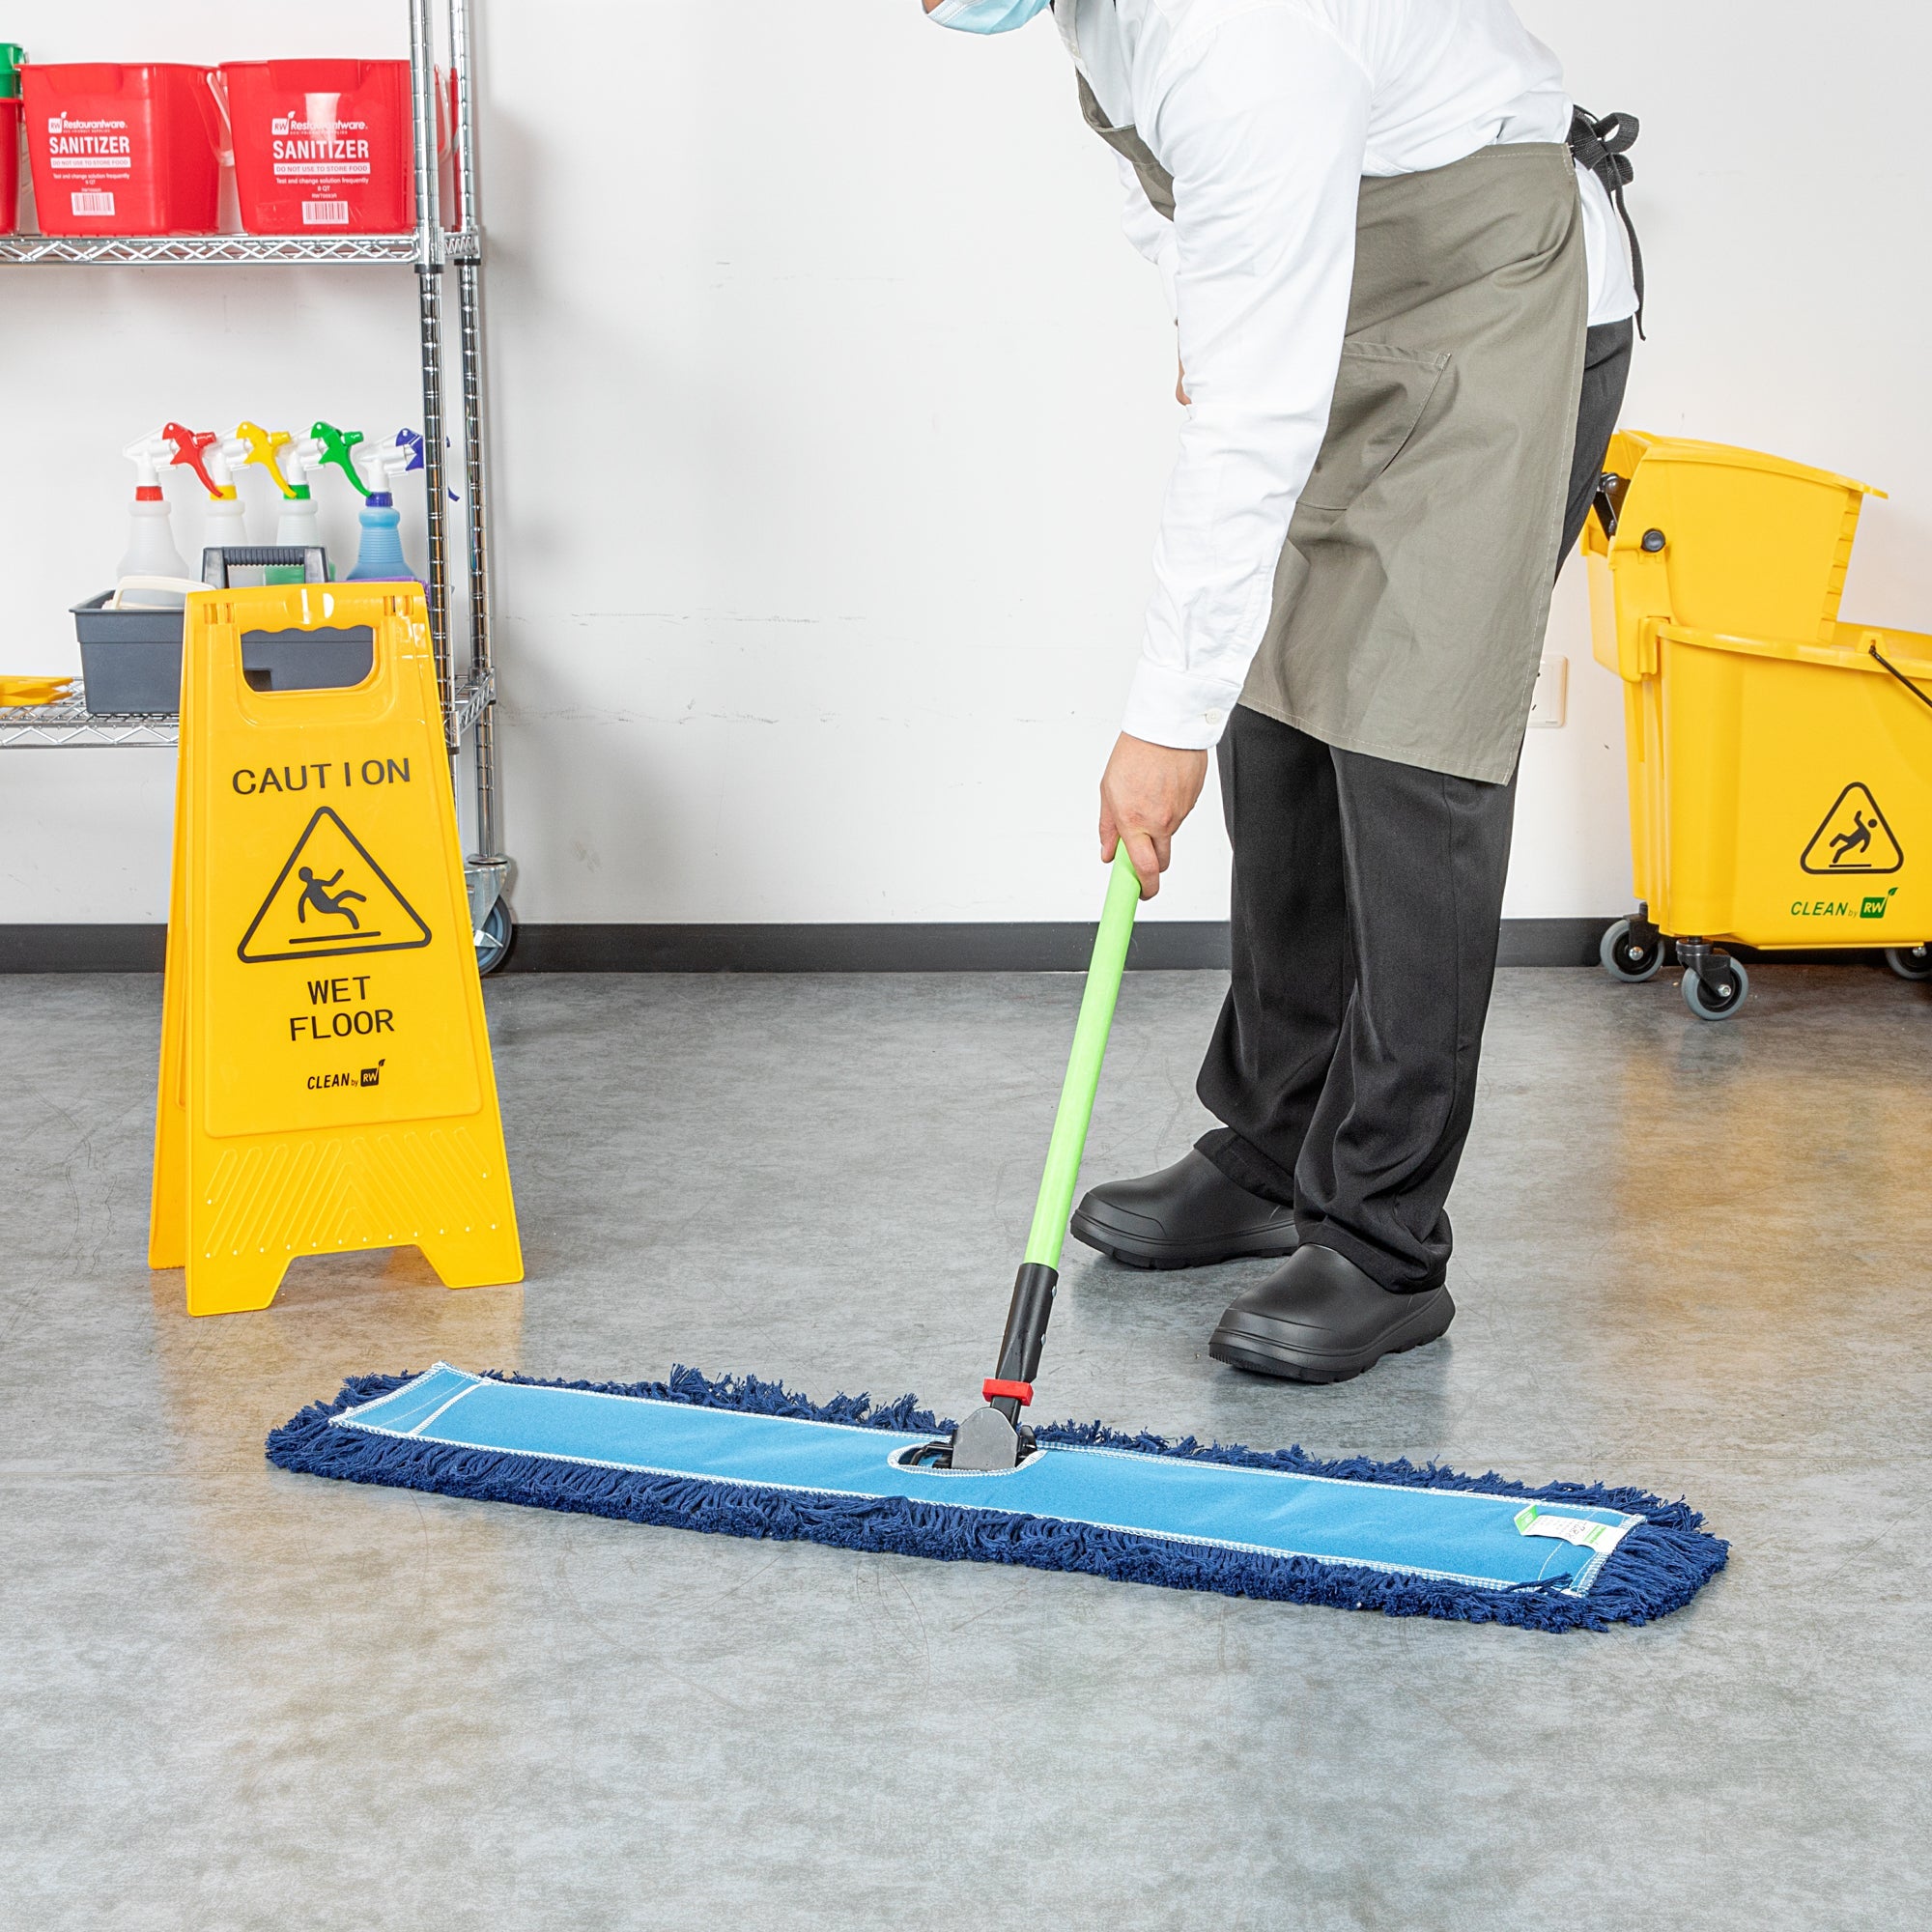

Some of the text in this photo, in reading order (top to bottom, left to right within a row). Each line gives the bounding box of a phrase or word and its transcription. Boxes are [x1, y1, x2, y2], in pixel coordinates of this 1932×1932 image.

[49, 136, 130, 155] SANITIZER
[272, 140, 369, 159] SANITIZER
[232, 757, 411, 795] CAUTION
[1790, 901, 1848, 916] CLEAN
[1848, 909, 1859, 919] by
[307, 976, 371, 1005] WET
[290, 1009, 395, 1041] FLOOR
[307, 1072, 350, 1090] CLEAN
